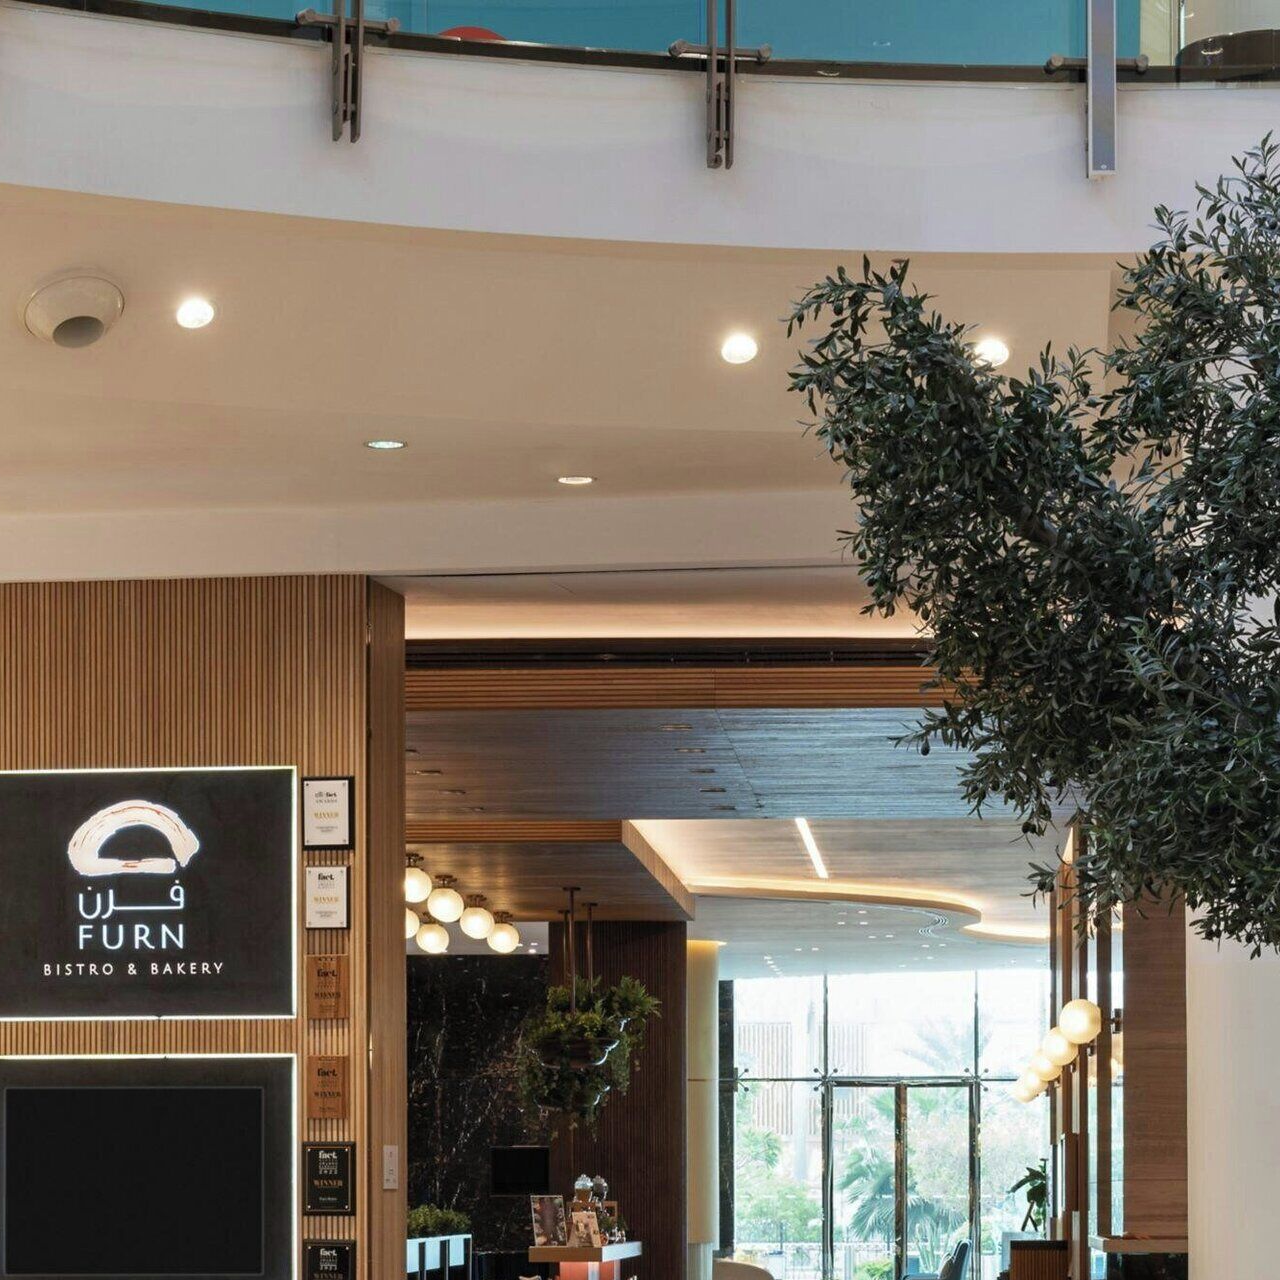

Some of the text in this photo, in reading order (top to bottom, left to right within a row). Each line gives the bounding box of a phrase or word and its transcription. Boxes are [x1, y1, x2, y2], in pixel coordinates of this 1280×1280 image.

[79, 879, 185, 920] فرن
[78, 923, 184, 950] FURN
[43, 962, 223, 976] BISTRO & BAKERY
